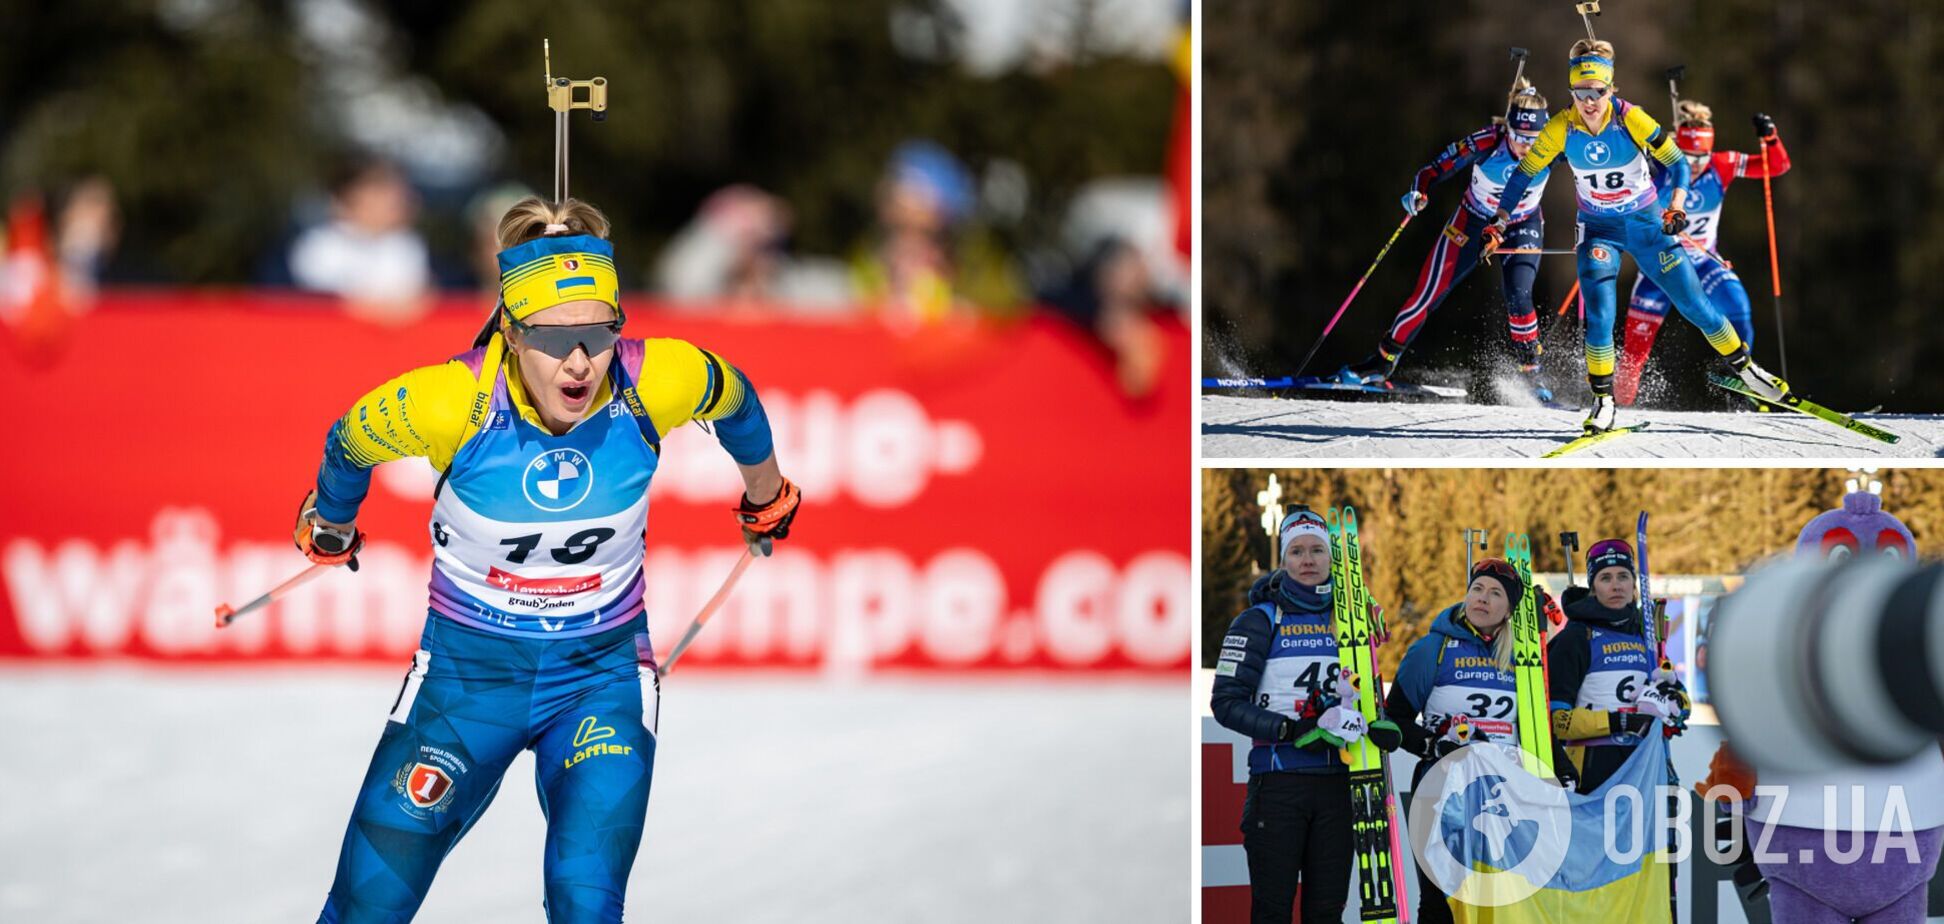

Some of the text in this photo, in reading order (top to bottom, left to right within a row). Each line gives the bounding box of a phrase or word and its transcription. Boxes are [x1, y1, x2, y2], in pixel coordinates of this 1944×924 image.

[1583, 171, 1625, 190] 18
[508, 298, 529, 312] OGAZ
[608, 402, 634, 419] BM
[534, 451, 584, 471] BMW
[1330, 533, 1348, 624] FISCHER
[1348, 532, 1365, 622] FISCHER
[1521, 558, 1538, 644] FISCHER
[1281, 638, 1323, 649] Garage
[1294, 662, 1341, 693] 48
[1455, 670, 1495, 681] Garage
[1616, 675, 1635, 703] 6
[1464, 693, 1514, 719] 32
[564, 742, 633, 769] Löffler
[415, 773, 438, 801] 1
